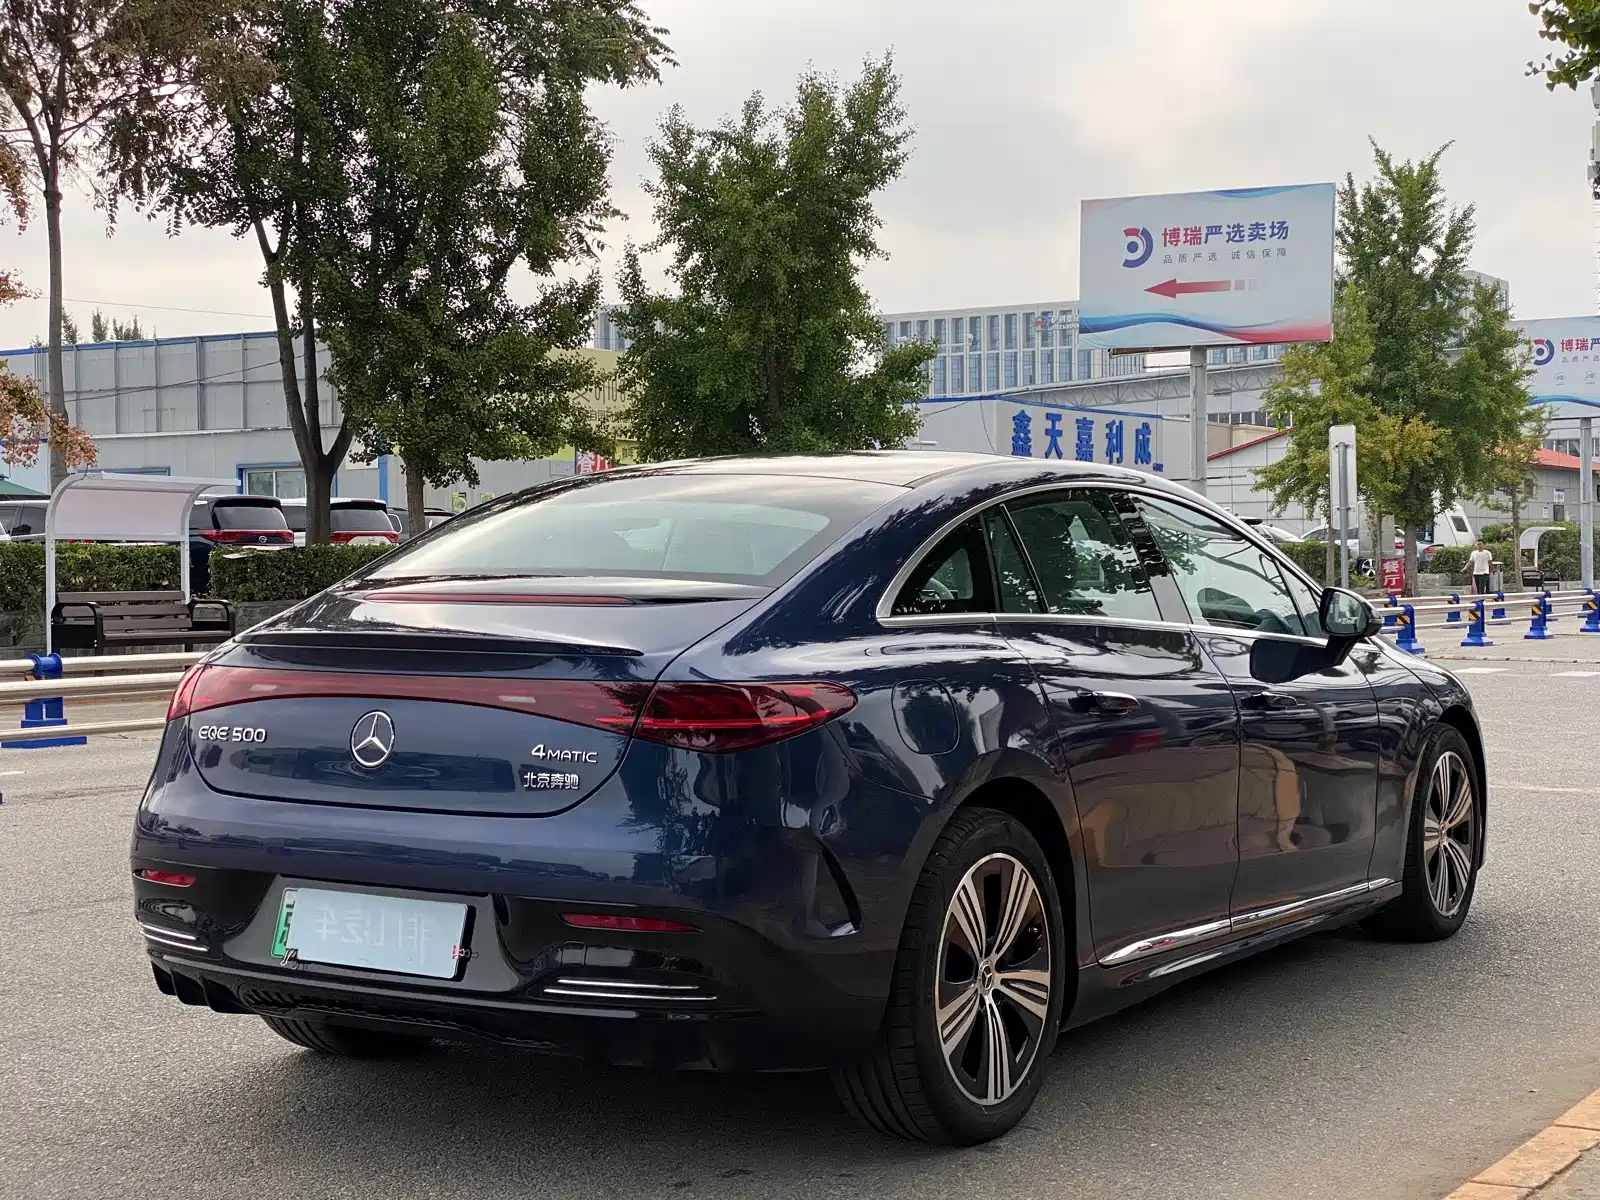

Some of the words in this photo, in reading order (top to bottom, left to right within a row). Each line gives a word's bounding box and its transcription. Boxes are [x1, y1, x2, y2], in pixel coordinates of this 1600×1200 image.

[1162, 220, 1289, 248] 博瑞严选卖场
[1163, 252, 1220, 265] 品质严选
[1231, 247, 1287, 261] 诚信保障
[1011, 409, 1153, 465] 鑫天嘉利成
[1382, 559, 1401, 593] 餐厅
[198, 725, 229, 741] EQE
[232, 727, 267, 743] 500
[531, 744, 598, 763] 4MATIC
[523, 772, 579, 789] 北京奔驰
